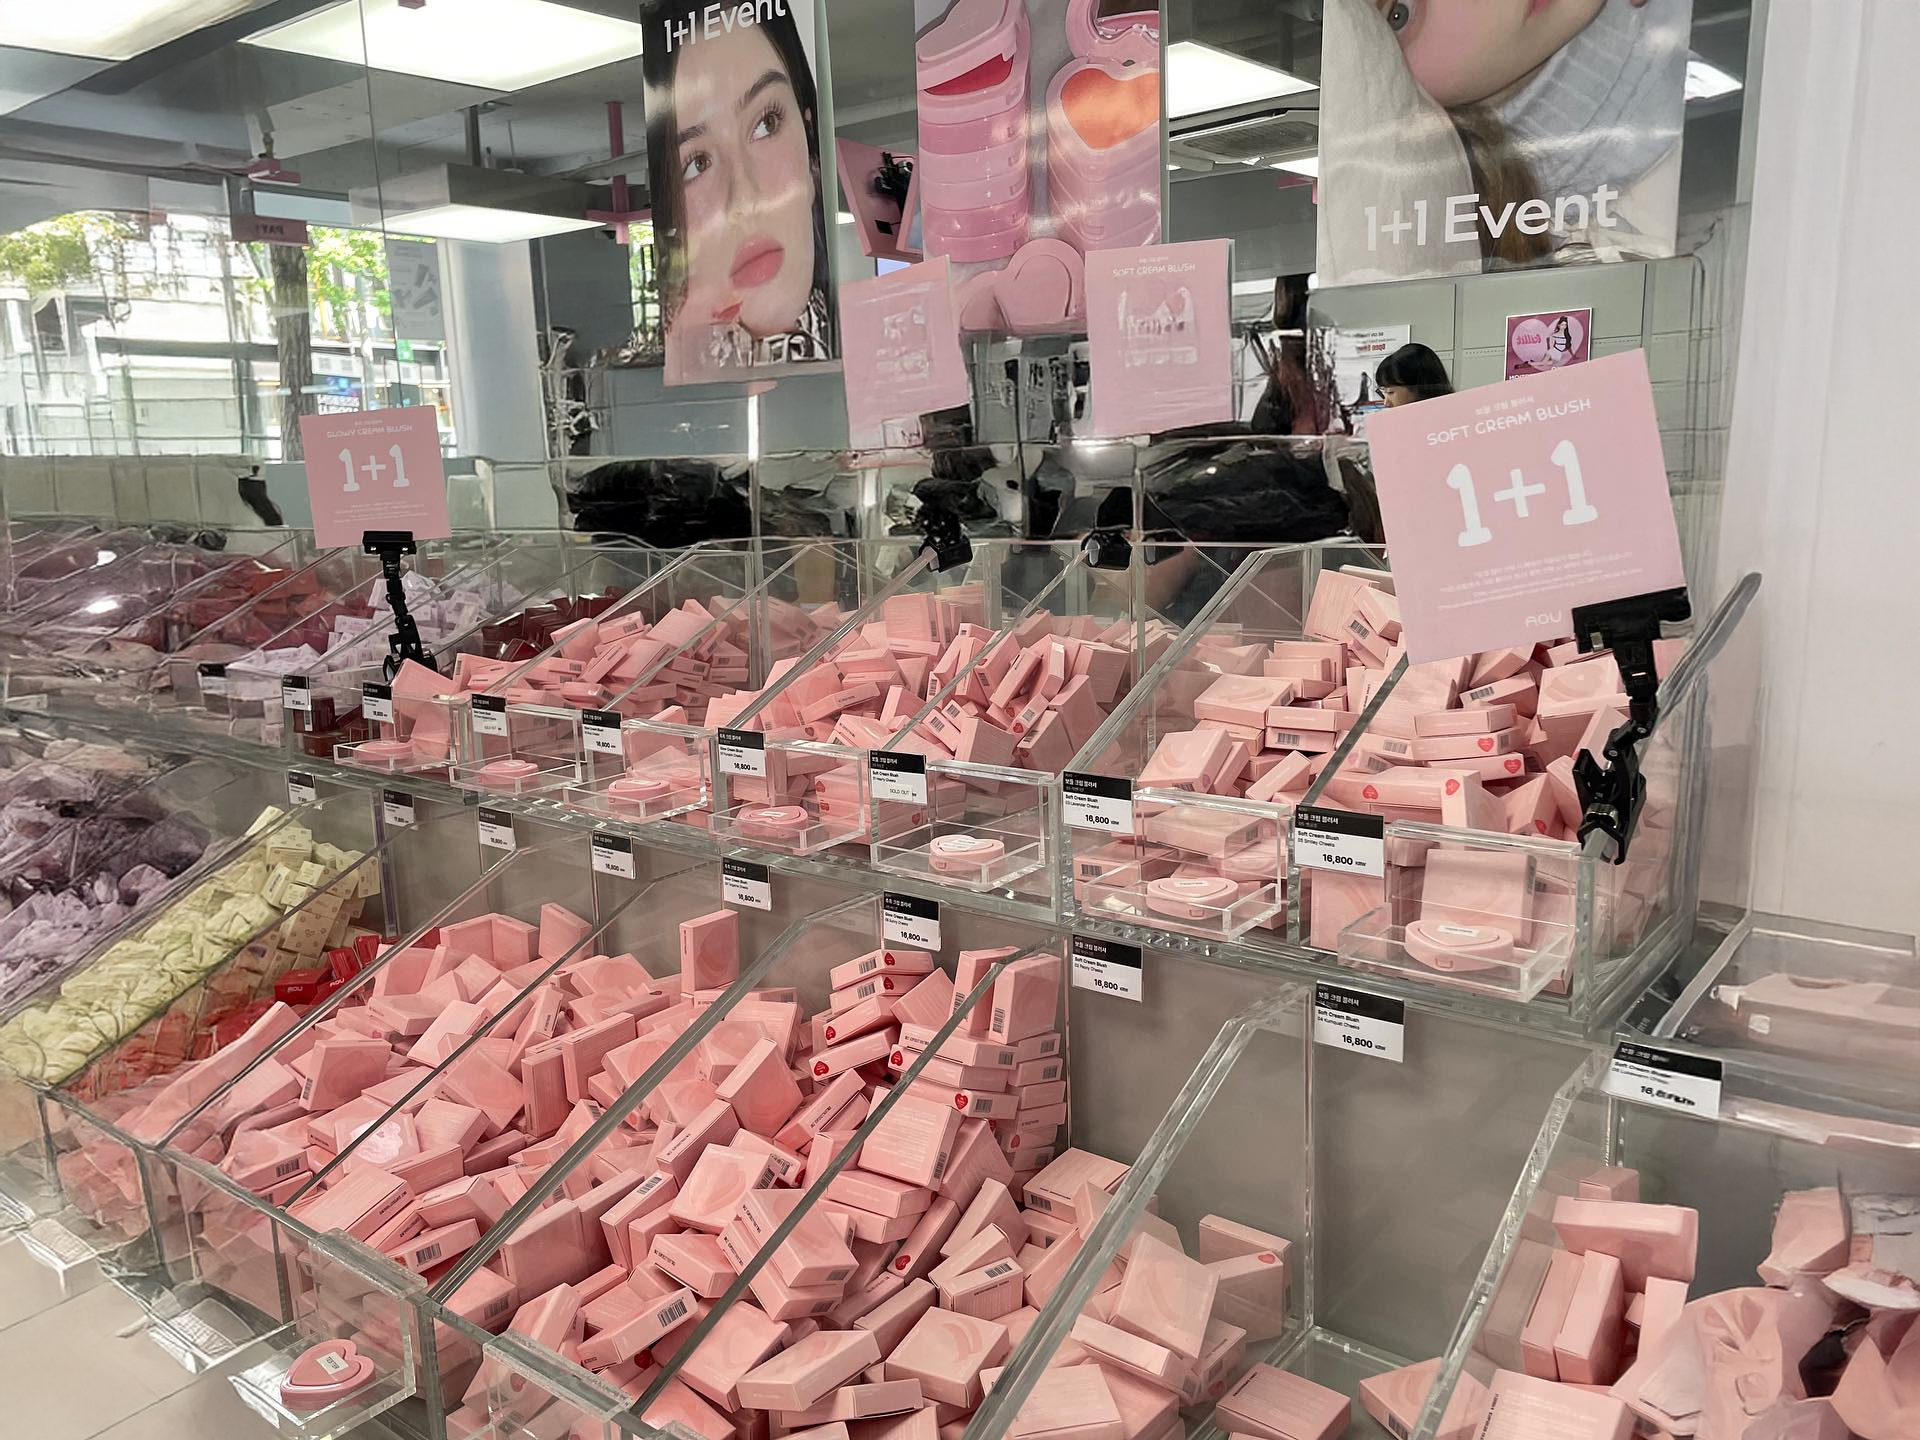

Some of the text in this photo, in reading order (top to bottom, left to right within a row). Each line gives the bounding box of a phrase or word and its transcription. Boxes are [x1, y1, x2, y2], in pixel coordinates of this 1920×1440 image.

[664, 11, 696, 53] 1+1
[1364, 184, 1619, 251] 1+1 Event
[1112, 268, 1135, 277] SOFT
[1168, 263, 1196, 273] BLUSH
[1426, 398, 1592, 446] SOFT CREAM BLUSH
[338, 444, 410, 492] 1+1
[1446, 439, 1599, 547] 1+1
[1085, 815, 1110, 824] 16,800
[1323, 854, 1353, 865] 16,800
[901, 931, 920, 941] 16,800
[1094, 979, 1118, 990] 16,800
[1342, 1034, 1372, 1048] 16,800
